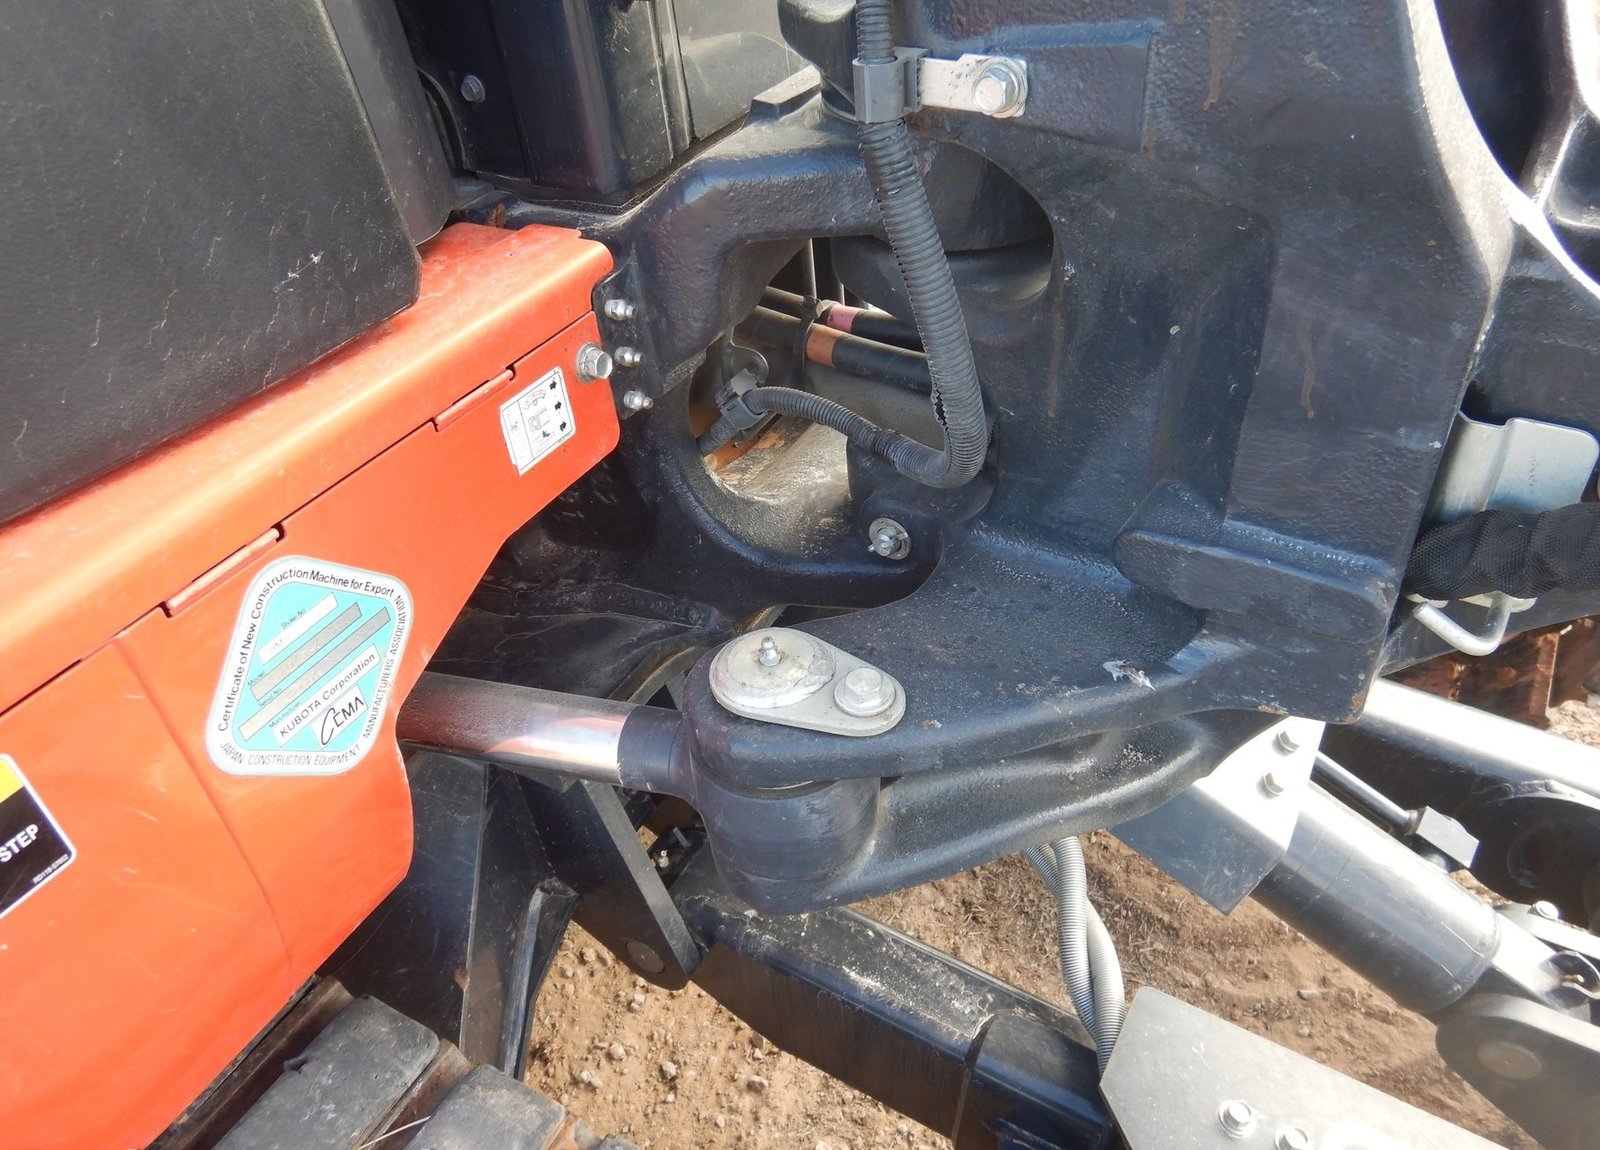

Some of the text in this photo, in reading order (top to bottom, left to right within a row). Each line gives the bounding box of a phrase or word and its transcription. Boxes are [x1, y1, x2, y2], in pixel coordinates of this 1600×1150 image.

[309, 570, 349, 587] Machine
[350, 578, 363, 590] for
[364, 582, 395, 597] Export
[251, 569, 309, 619] Construction
[244, 623, 257, 645] New
[240, 650, 249, 664] of
[220, 595, 406, 766] JAPAN CONSTRUCTION EQUIPMENT MANUFACTURERS ASSOCIATION
[280, 654, 376, 737] KUBOTA Corporation
[218, 666, 246, 731] Certificate
[0, 824, 38, 862] STEP
